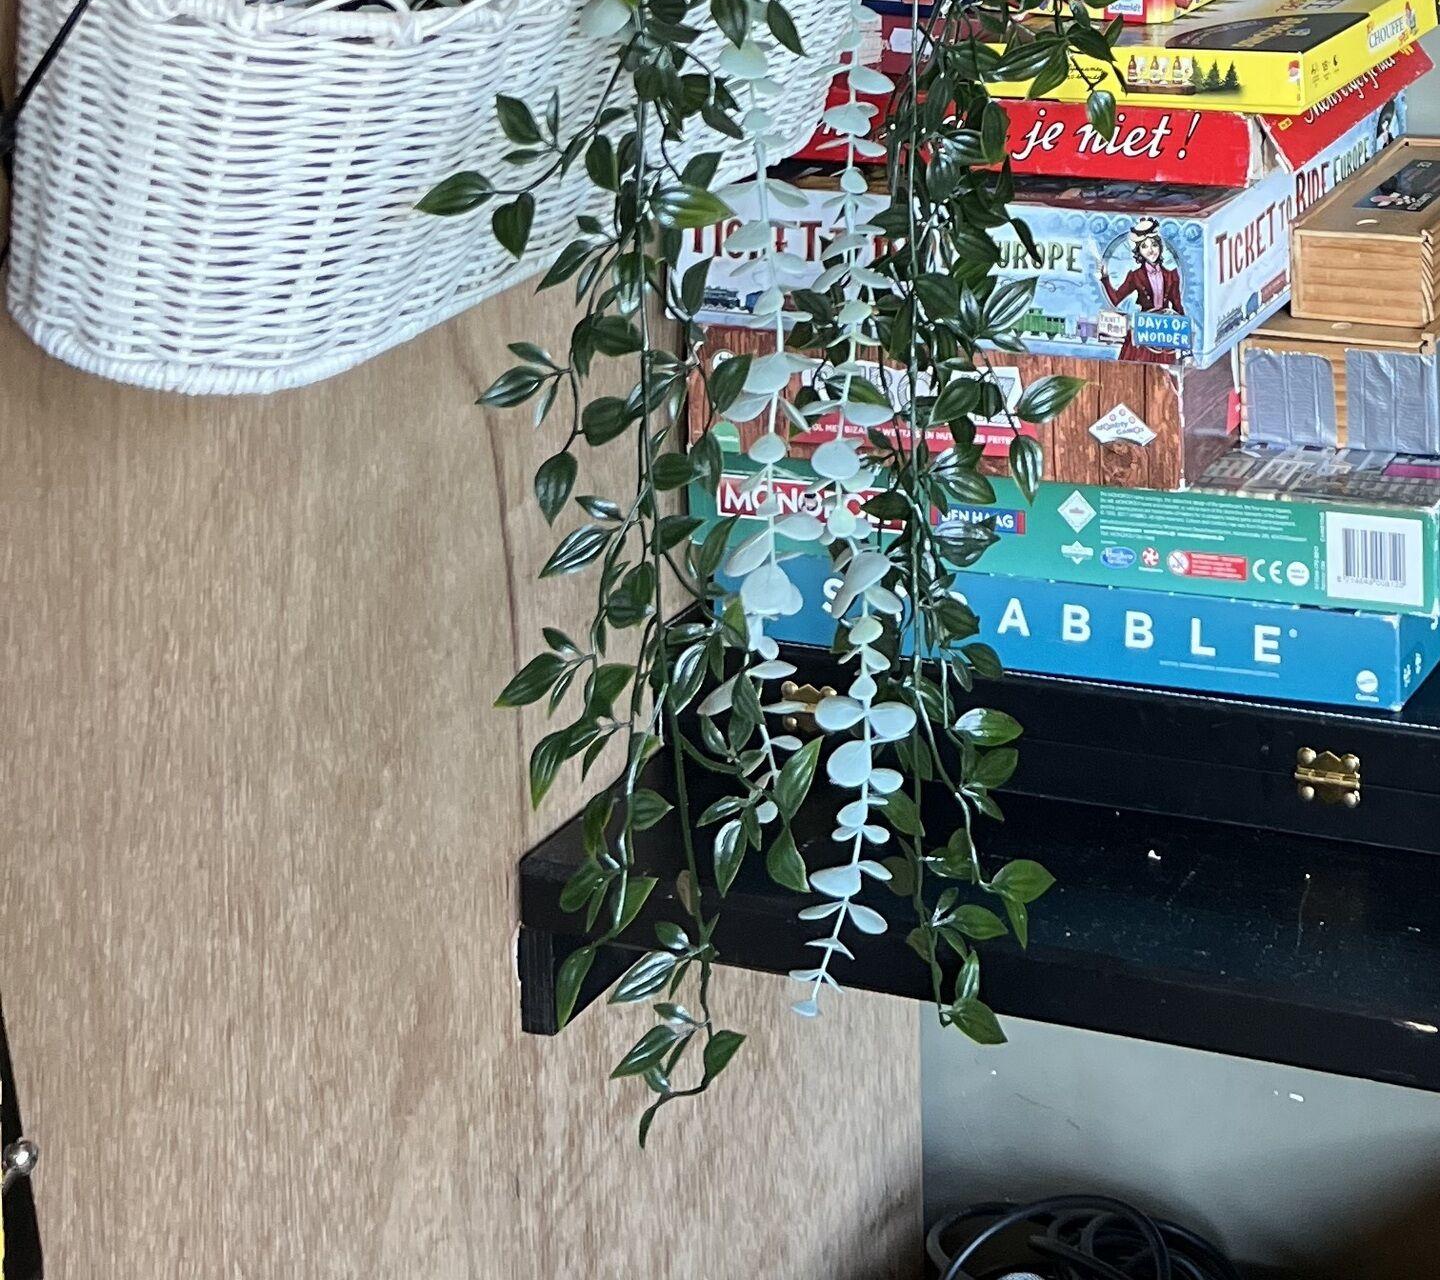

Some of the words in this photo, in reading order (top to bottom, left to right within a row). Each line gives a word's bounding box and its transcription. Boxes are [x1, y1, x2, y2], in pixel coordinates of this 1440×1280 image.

[1369, 15, 1404, 48] CHOUFFE
[1011, 107, 1066, 162] je
[995, 240, 1083, 274] UROPE
[1215, 201, 1277, 285] TICKET
[1137, 316, 1169, 329] DAYS
[1171, 318, 1189, 331] OF
[1137, 331, 1190, 346] WONDER
